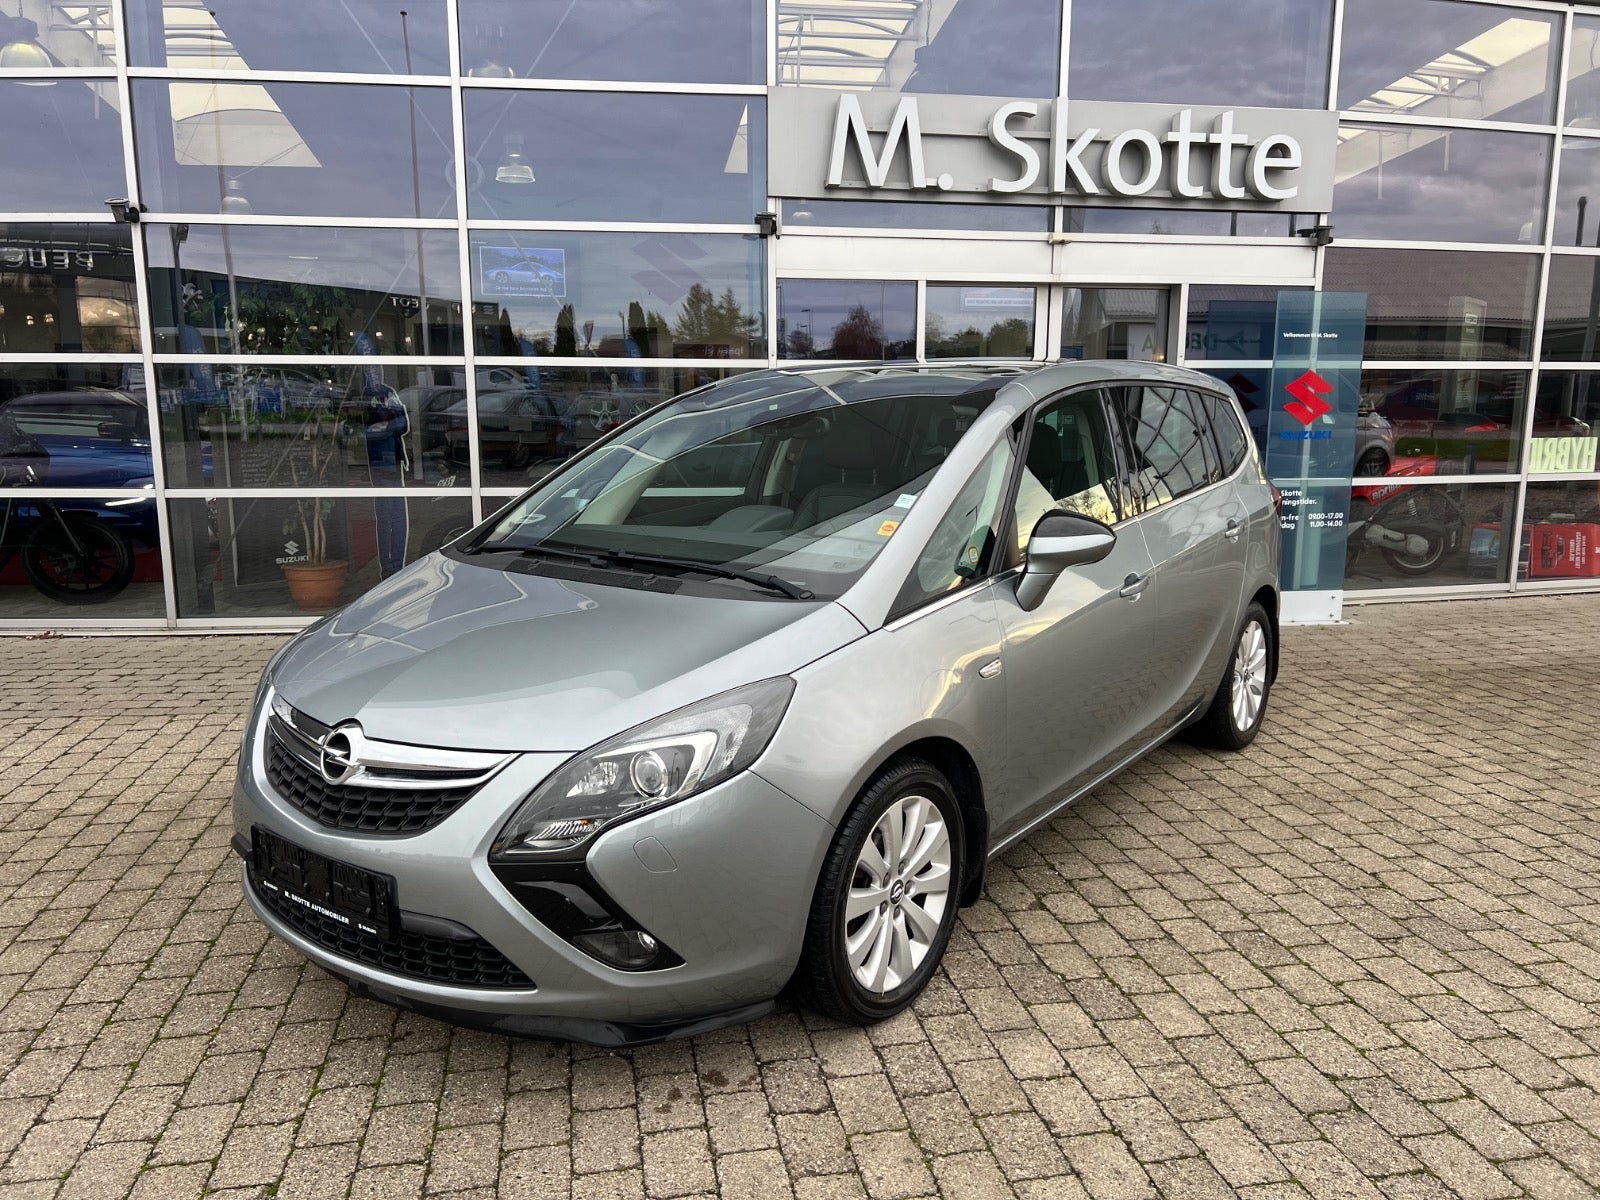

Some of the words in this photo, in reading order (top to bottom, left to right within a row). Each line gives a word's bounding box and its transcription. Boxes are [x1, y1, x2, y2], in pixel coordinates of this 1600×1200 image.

[824, 93, 954, 191] M.
[987, 96, 1302, 201] Skotte
[1280, 430, 1333, 440] SUZUKI
[1281, 498, 1317, 506] ningstider.
[1281, 513, 1300, 521] n-fre
[1281, 522, 1296, 530] dag
[275, 555, 309, 564] SUZUKI
[291, 893, 311, 908] SKOTTE
[311, 903, 350, 924] AUTOMOBILER
